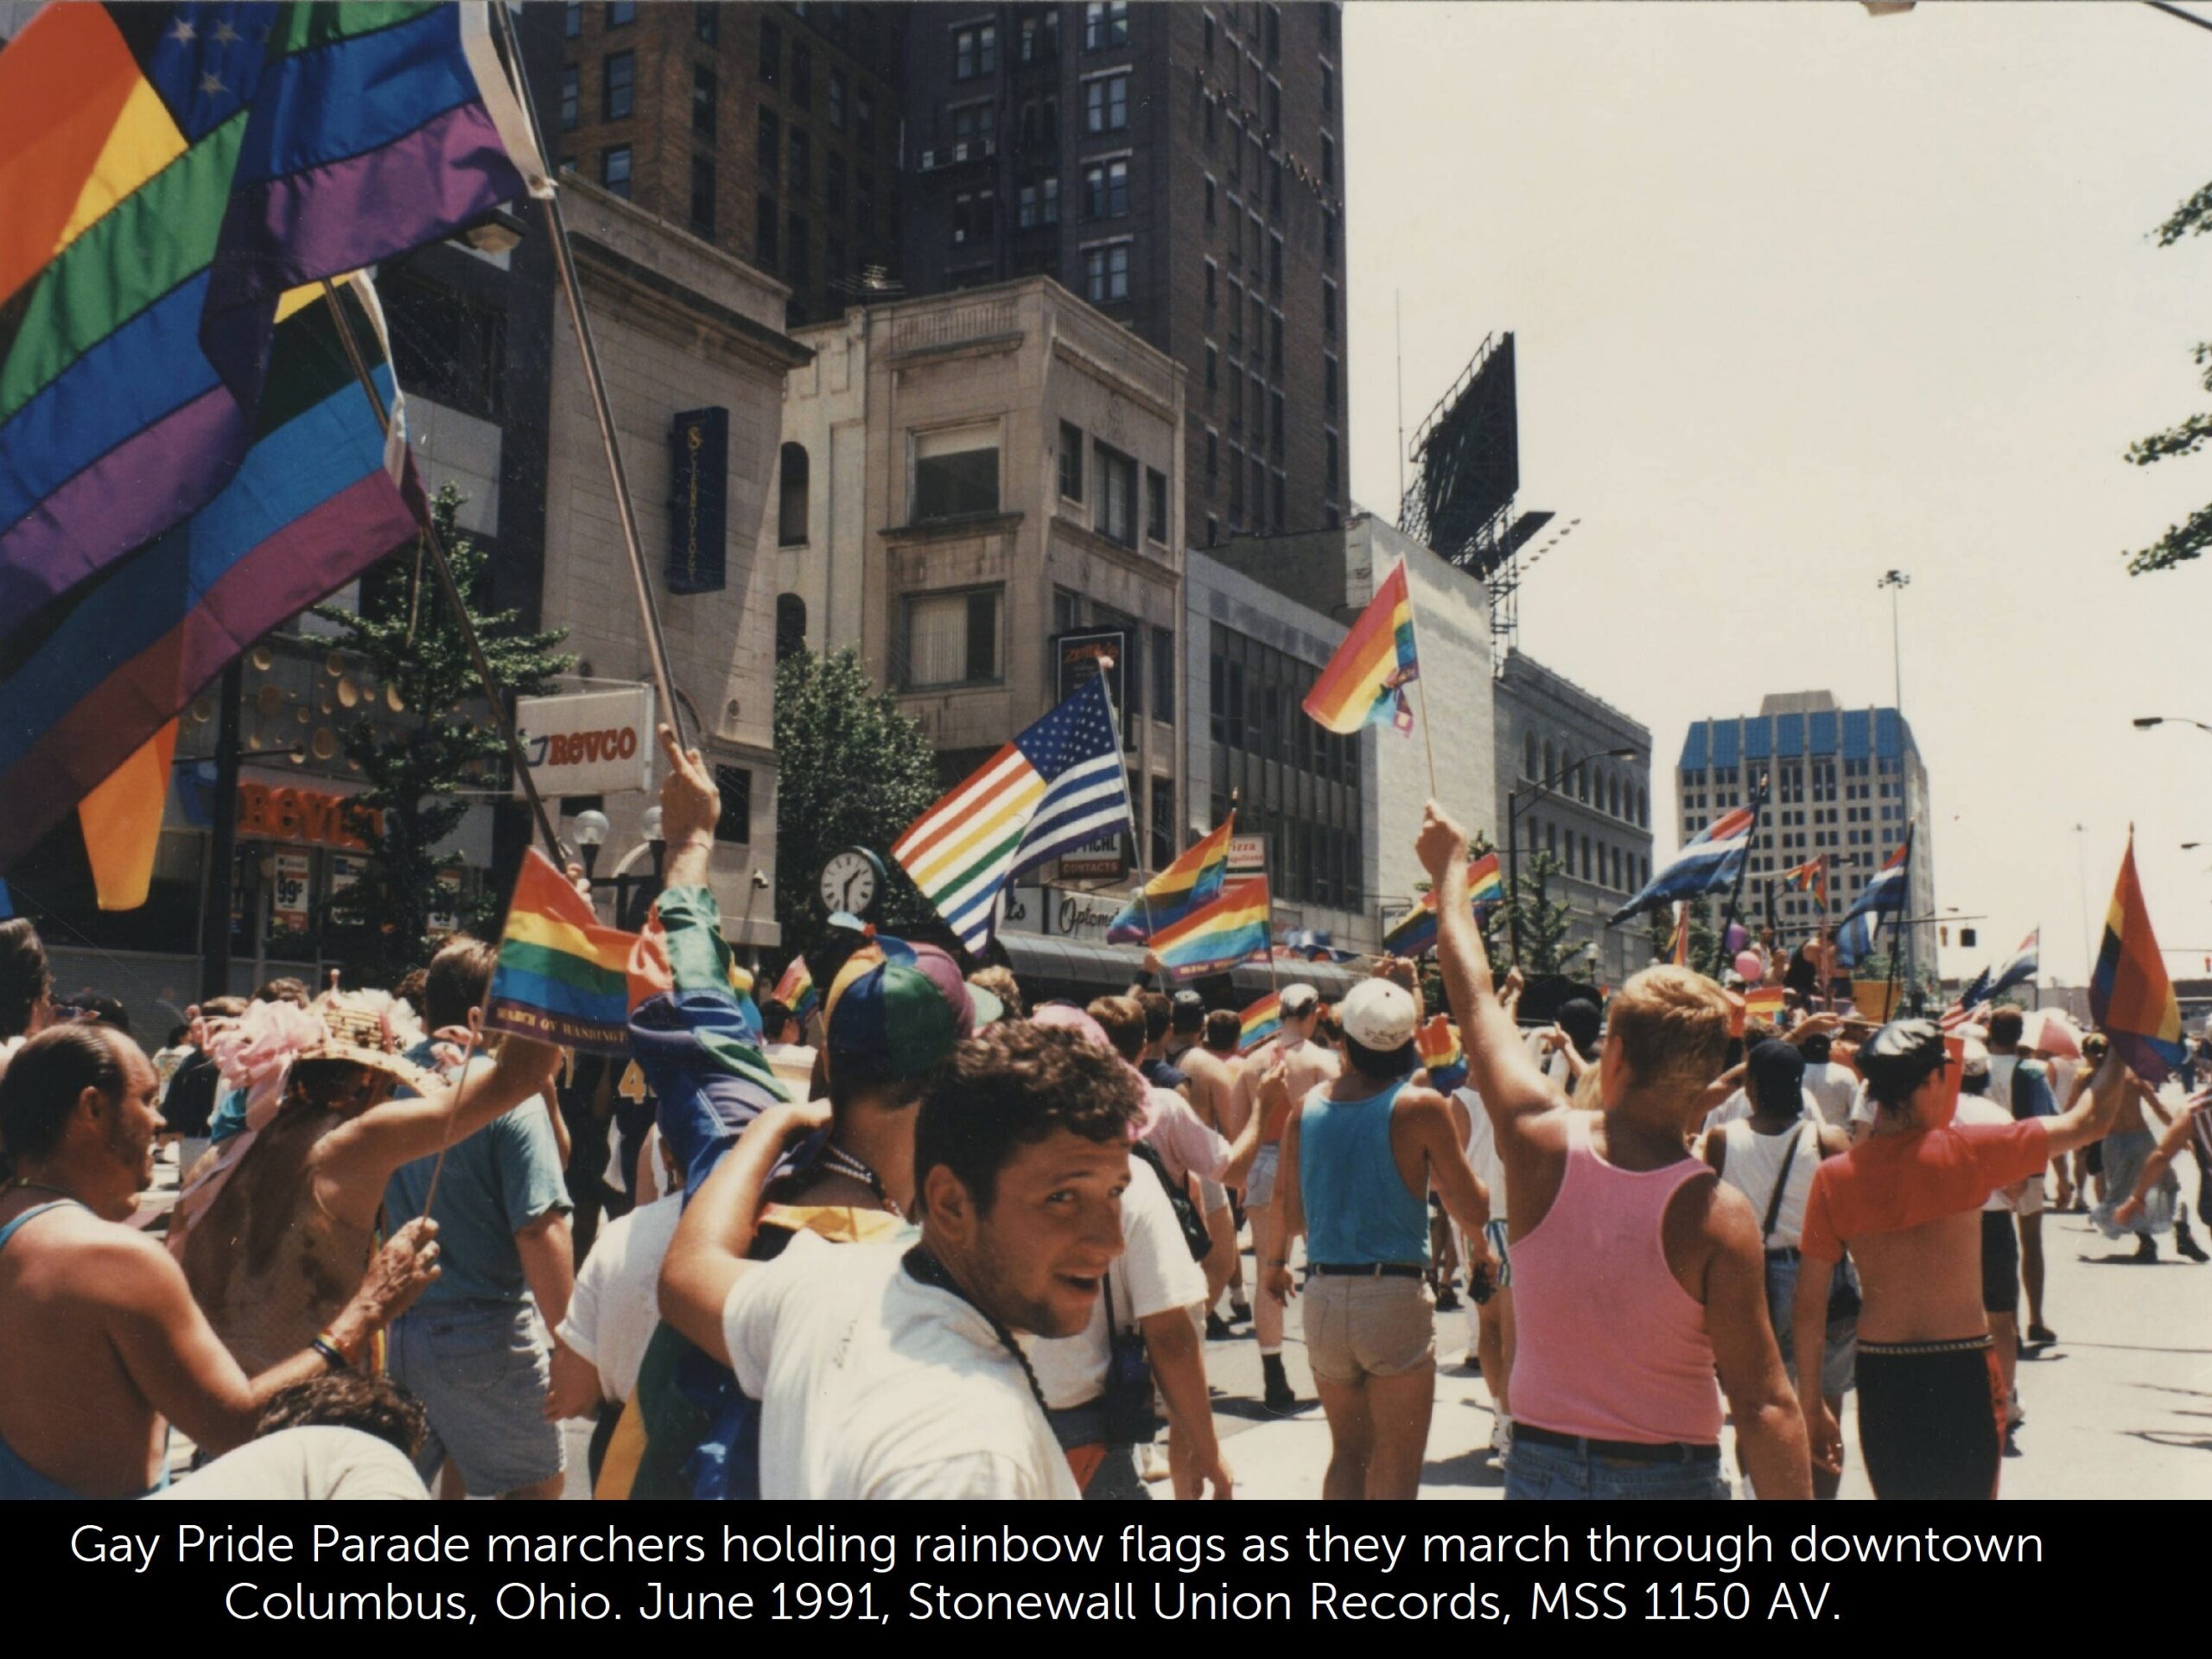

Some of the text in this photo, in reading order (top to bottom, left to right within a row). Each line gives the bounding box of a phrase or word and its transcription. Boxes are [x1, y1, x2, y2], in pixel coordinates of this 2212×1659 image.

[1230, 840, 1256, 852] izza
[1064, 861, 1119, 873] CONTACTS
[1059, 898, 1120, 938] Optome
[563, 1022, 627, 1044] WASHINGT
